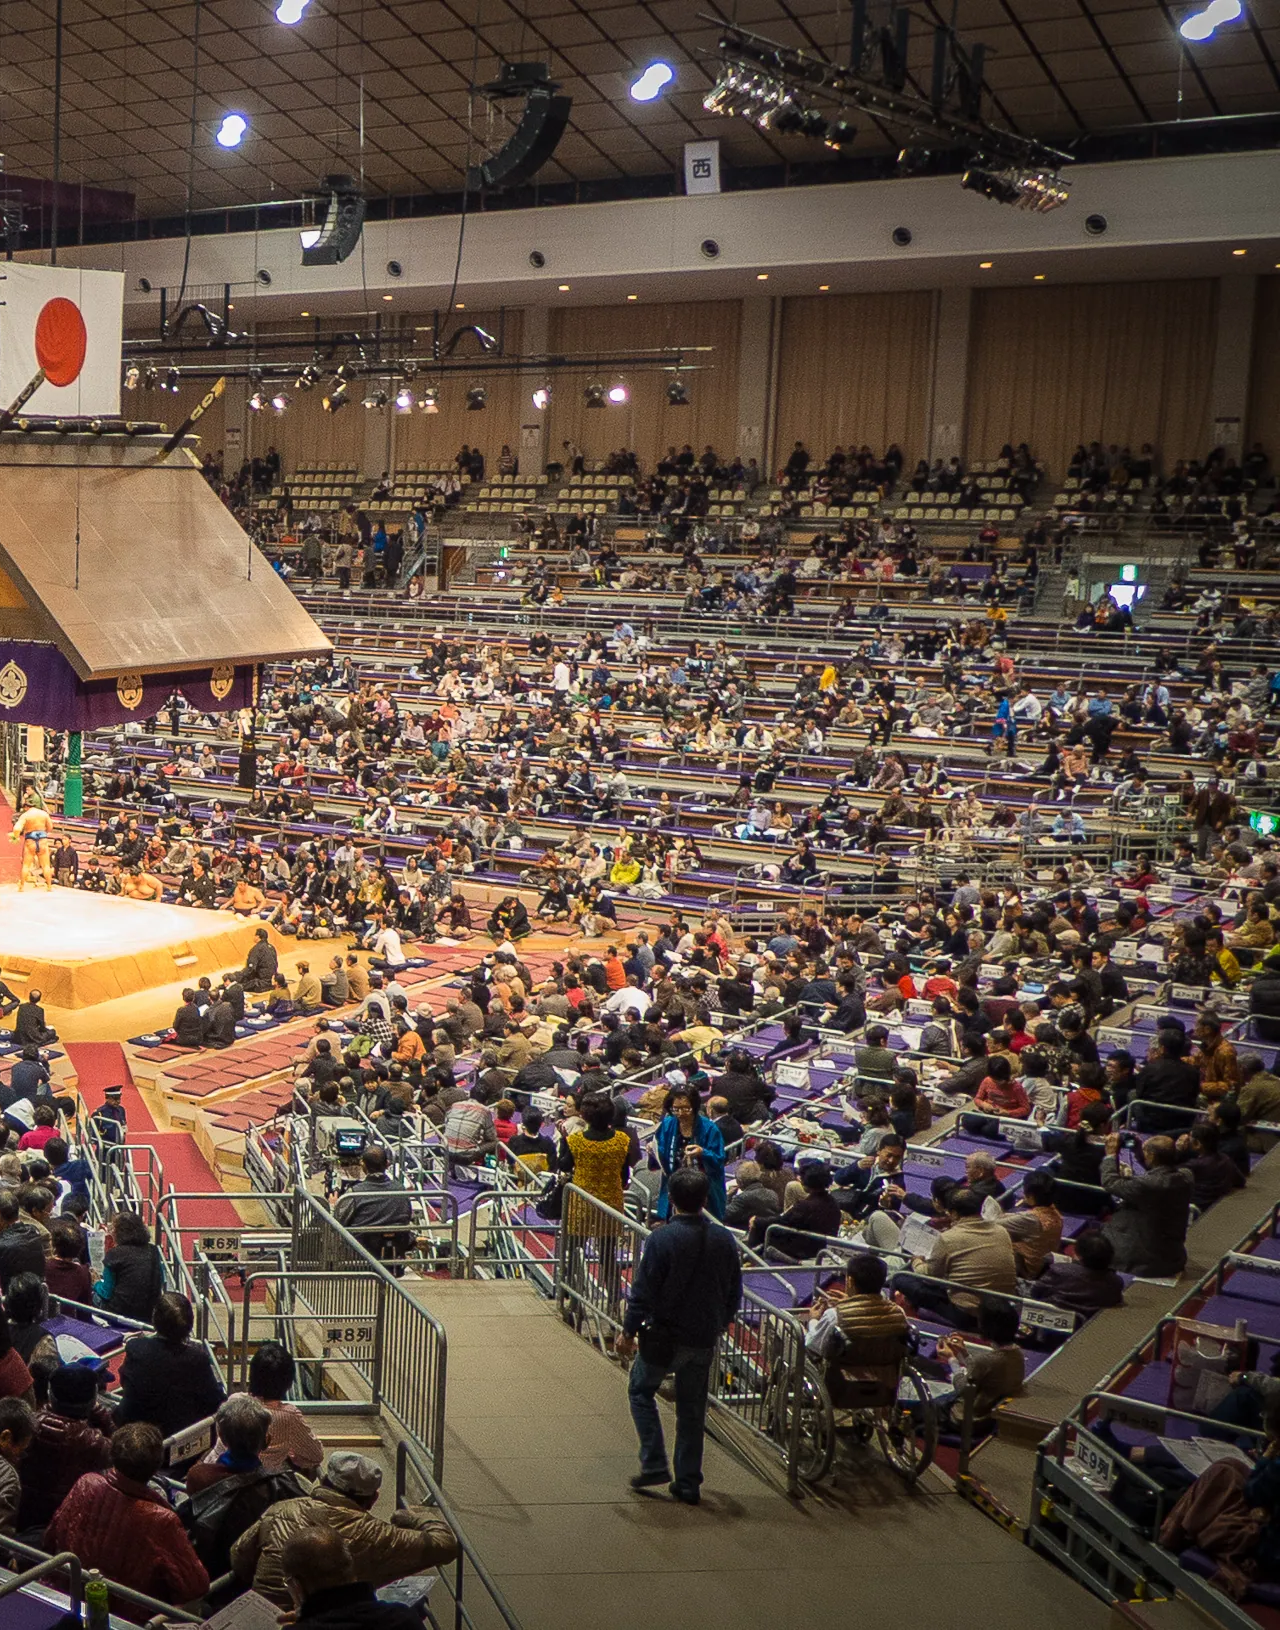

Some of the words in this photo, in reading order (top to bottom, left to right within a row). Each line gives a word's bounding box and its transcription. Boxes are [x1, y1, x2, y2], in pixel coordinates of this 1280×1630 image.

[692, 158, 711, 178] 西
[202, 1237, 239, 1250] 東6列
[326, 1327, 373, 1343] 東8列
[1078, 1442, 1110, 1480] 正9列
